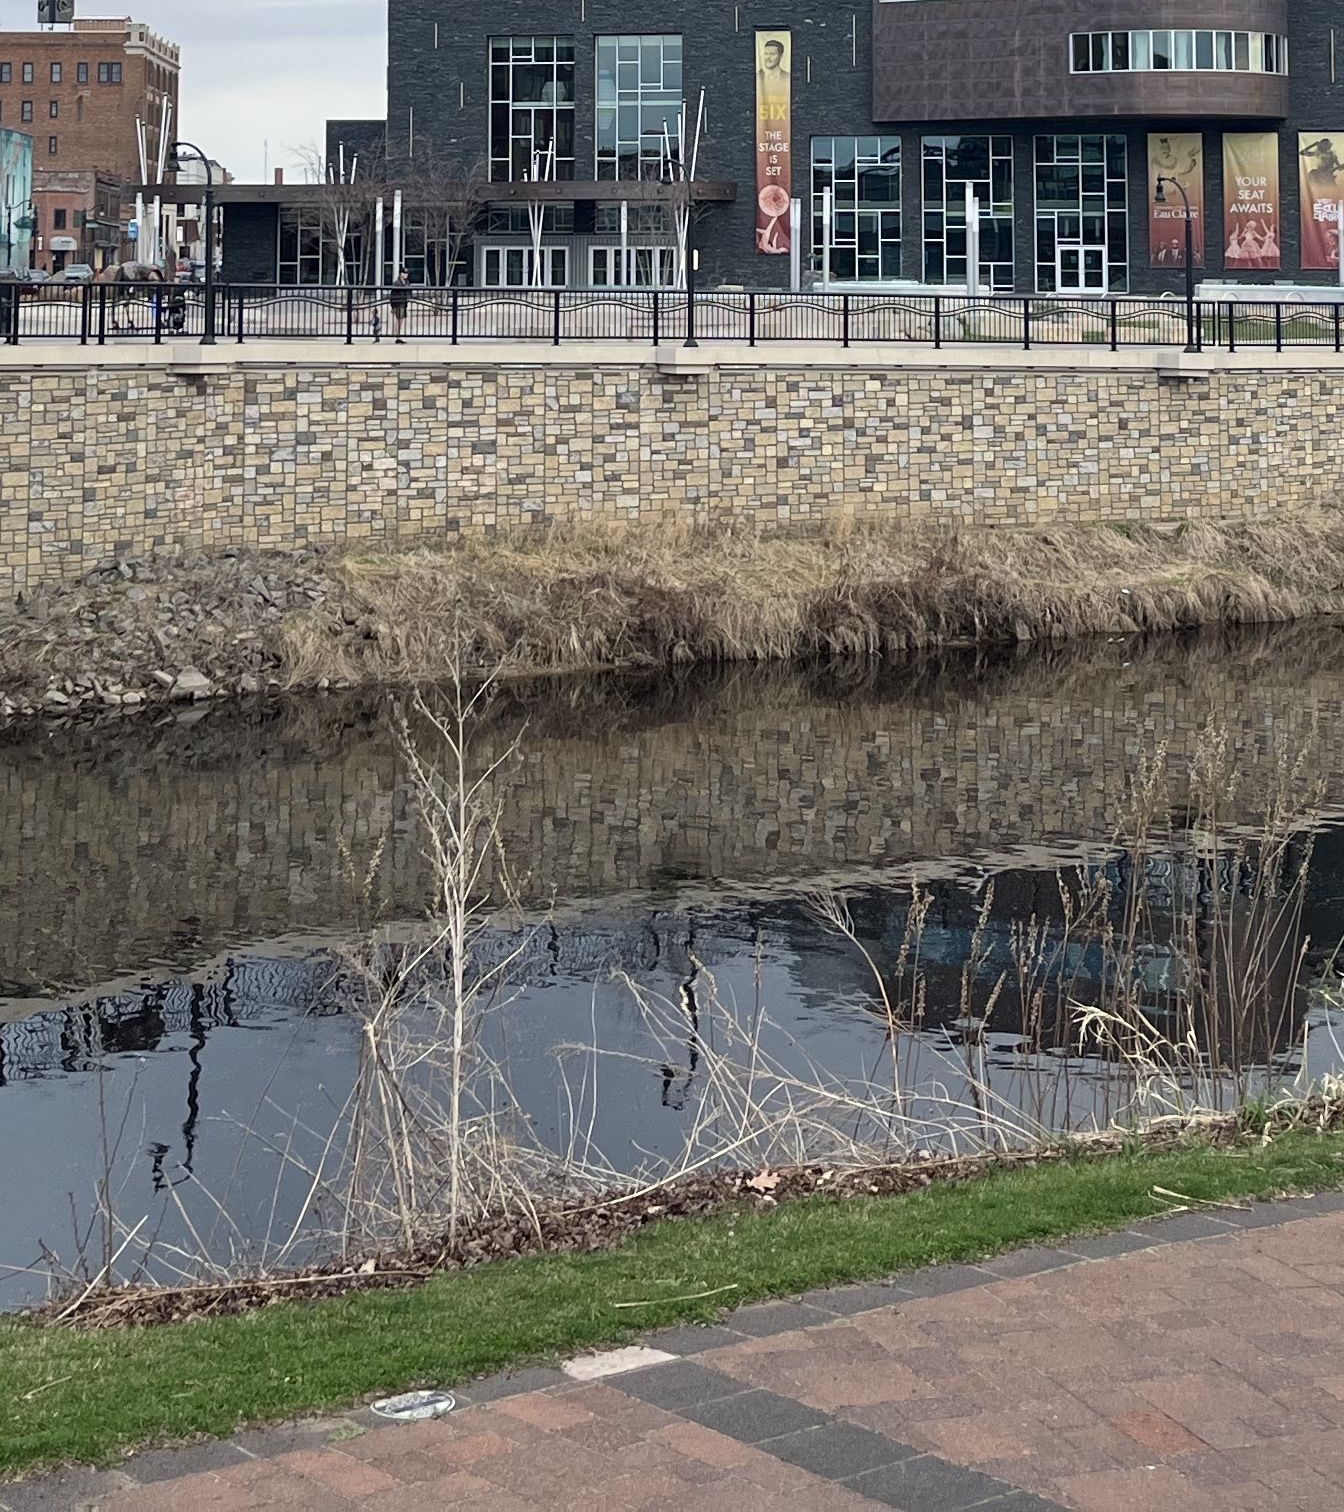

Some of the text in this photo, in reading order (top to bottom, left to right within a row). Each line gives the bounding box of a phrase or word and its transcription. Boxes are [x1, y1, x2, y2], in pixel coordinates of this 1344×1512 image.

[760, 104, 786, 120] SIX
[765, 131, 782, 140] THE
[758, 143, 789, 152] STAGE
[769, 154, 778, 164] IS
[765, 166, 782, 176] SET
[1235, 176, 1267, 187] YOUR
[1238, 189, 1265, 200] SEAT
[1229, 202, 1274, 214] AWAITS
[1154, 209, 1199, 219] Eau Clare
